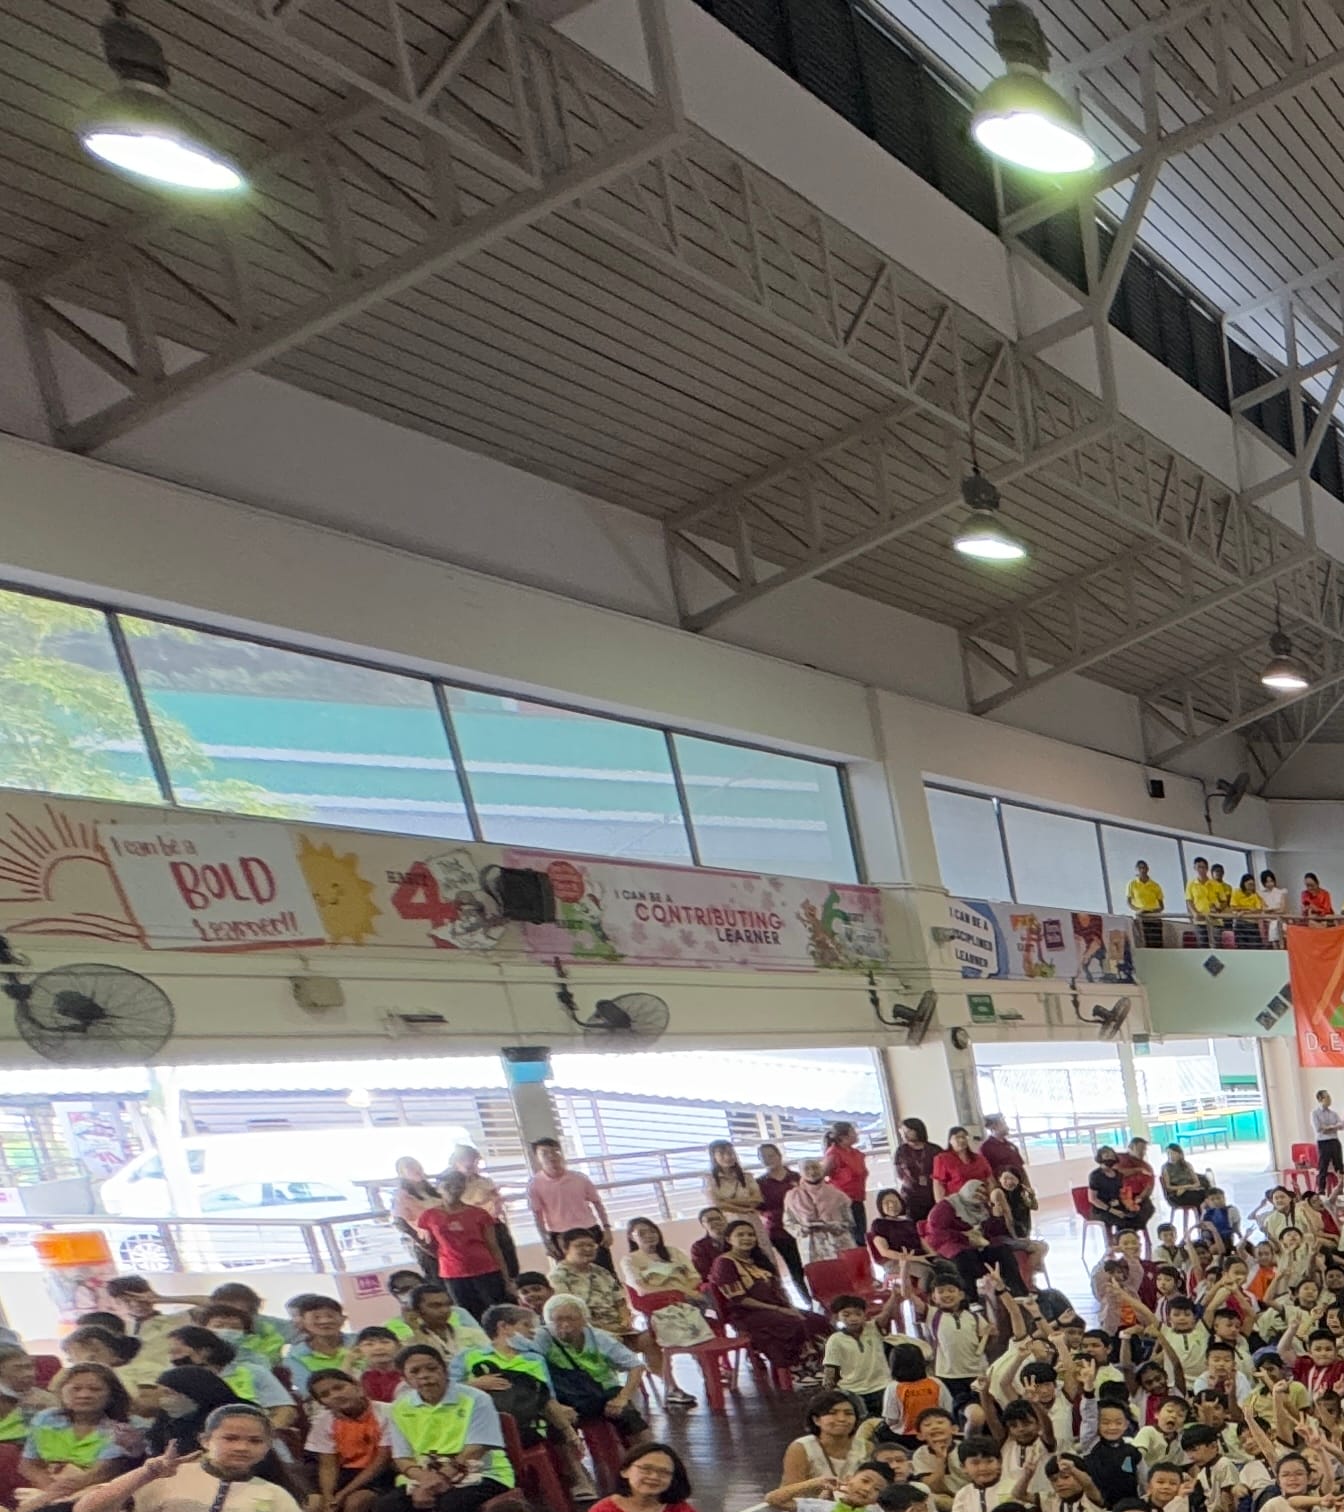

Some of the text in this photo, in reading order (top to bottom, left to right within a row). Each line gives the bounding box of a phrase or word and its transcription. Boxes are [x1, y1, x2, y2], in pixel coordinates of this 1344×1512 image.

[124, 839, 157, 857] can
[157, 834, 178, 857] be
[169, 856, 277, 911] BOLD
[622, 889, 646, 901] CAN
[650, 891, 661, 902] BE
[665, 894, 673, 903] A
[634, 902, 783, 930] CONTRIBUTING
[954, 909, 970, 924] CAN
[972, 916, 982, 929] BE
[716, 927, 781, 945] LEARNER
[955, 948, 989, 968] LEARNER
